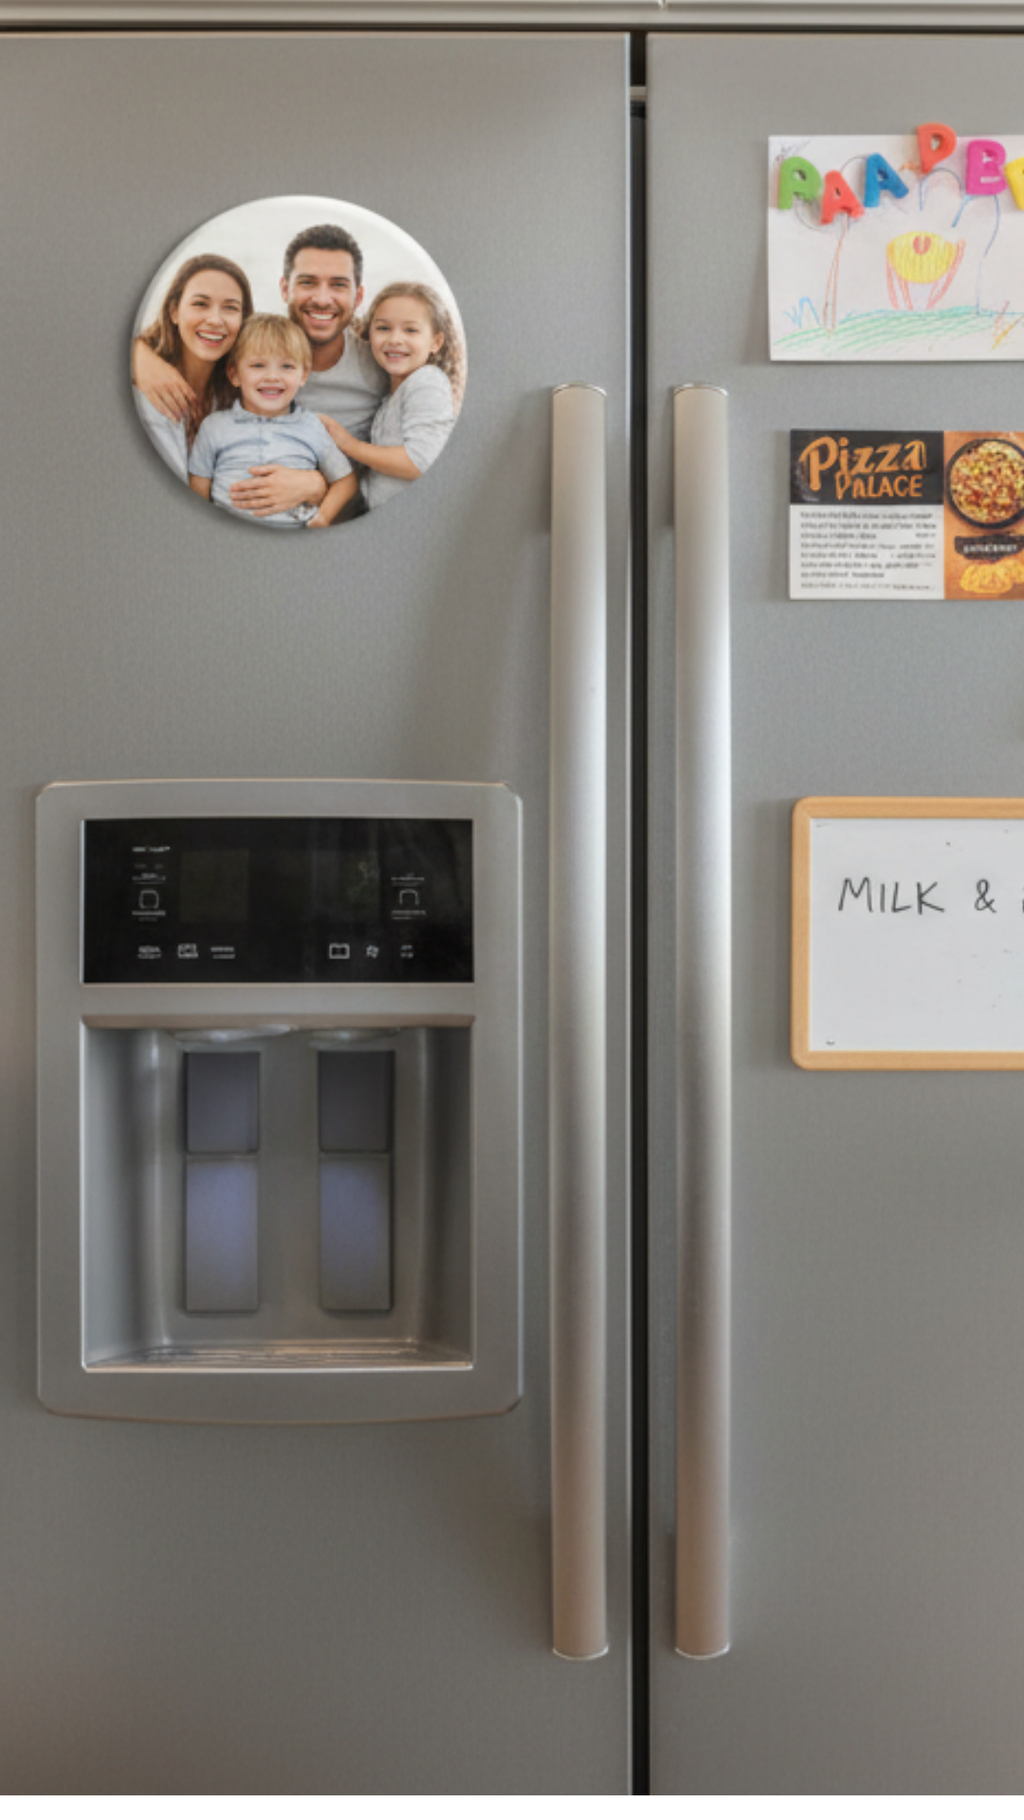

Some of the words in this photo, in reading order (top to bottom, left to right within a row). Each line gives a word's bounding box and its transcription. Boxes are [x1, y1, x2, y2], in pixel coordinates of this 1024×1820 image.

[799, 436, 927, 491] Pizza
[838, 876, 945, 915] MILK
[974, 879, 997, 914] &
